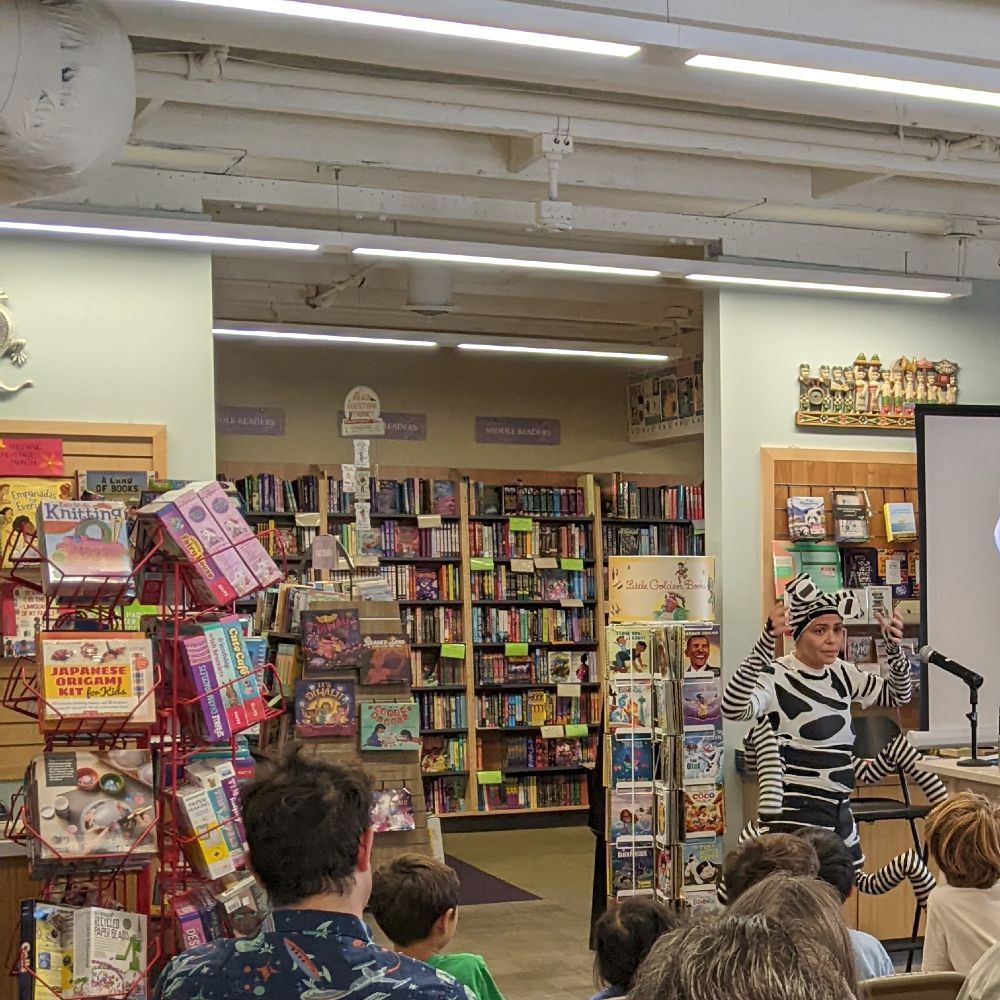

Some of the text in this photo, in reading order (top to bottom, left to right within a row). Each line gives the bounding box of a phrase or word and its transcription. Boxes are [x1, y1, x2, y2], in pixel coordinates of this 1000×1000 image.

[237, 417, 277, 427] READERS
[484, 425, 552, 437] MIDDLE READERS
[102, 476, 107, 484] A
[96, 484, 139, 493] OF BOOKS
[44, 501, 122, 520] Knitting
[625, 579, 649, 591] Little
[649, 580, 682, 591] Golden
[50, 666, 127, 676] JAPANESE
[56, 676, 123, 686] ORIGAMI
[58, 684, 127, 699] KIT for Kids
[692, 792, 715, 800] COCO
[94, 916, 120, 929] RECYCLED
[94, 926, 130, 940] PAPER BEADS
